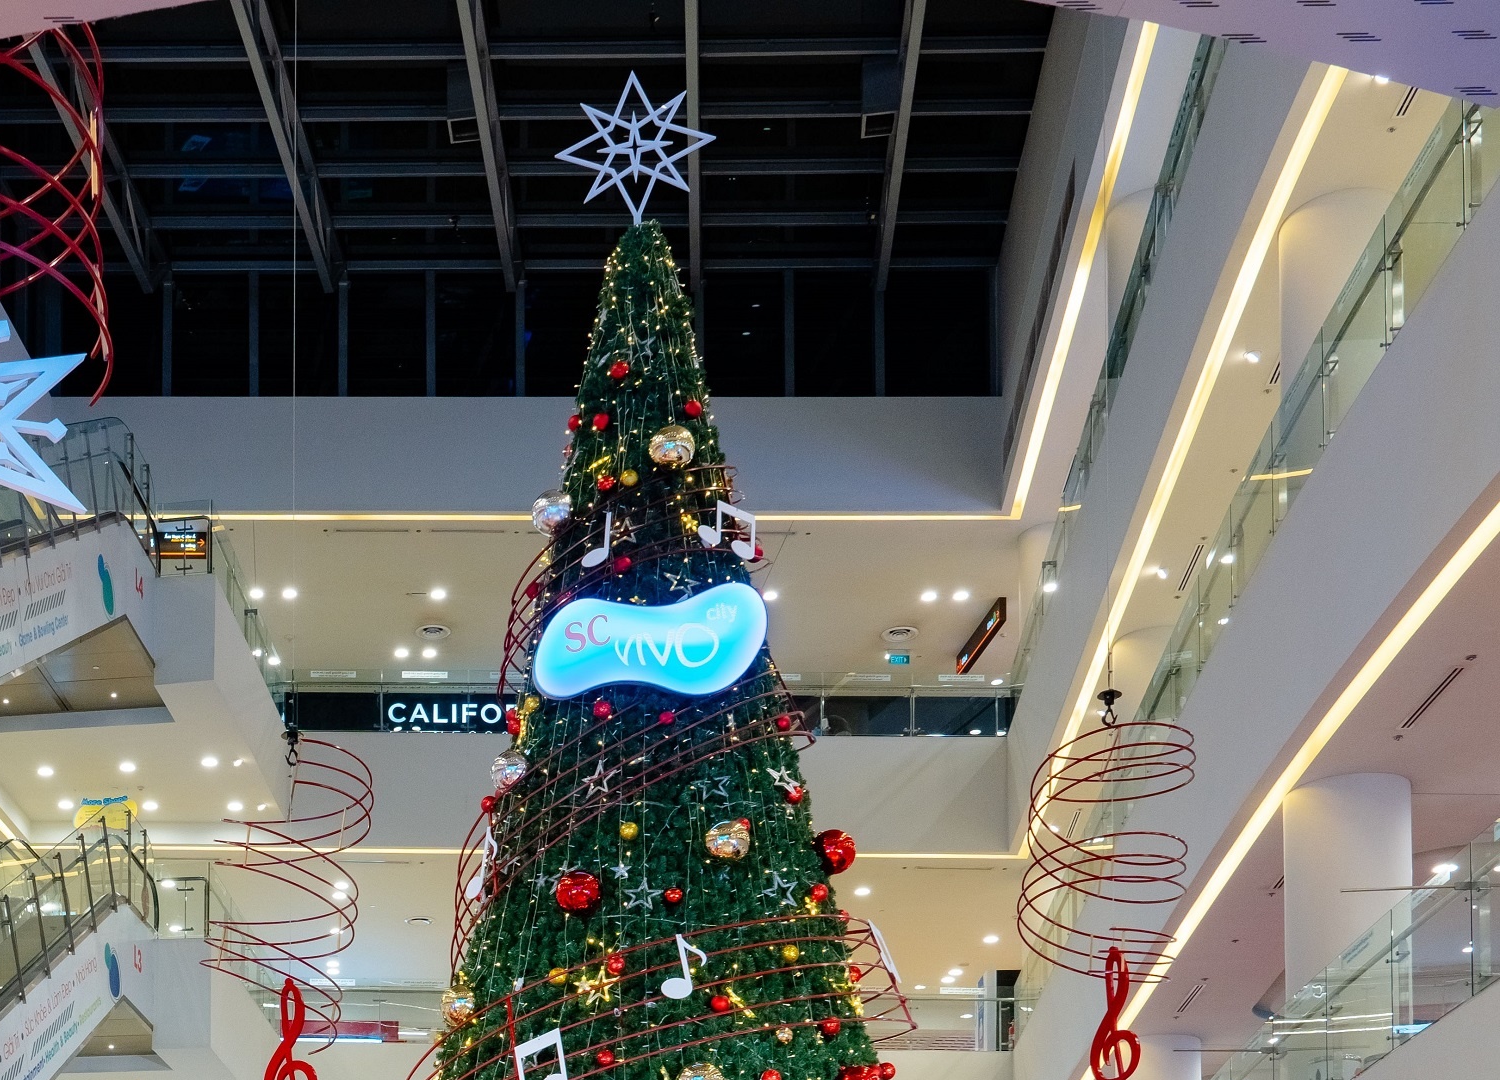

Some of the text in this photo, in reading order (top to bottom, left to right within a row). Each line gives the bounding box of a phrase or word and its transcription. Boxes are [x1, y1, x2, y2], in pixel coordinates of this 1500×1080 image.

[706, 602, 738, 623] city
[18, 629, 33, 647] Game
[38, 619, 55, 640] Bowling
[55, 614, 68, 634] Center
[564, 614, 611, 653] SC
[890, 656, 904, 664] EXIT
[388, 703, 514, 724] CALIFO
[133, 944, 142, 973] L3
